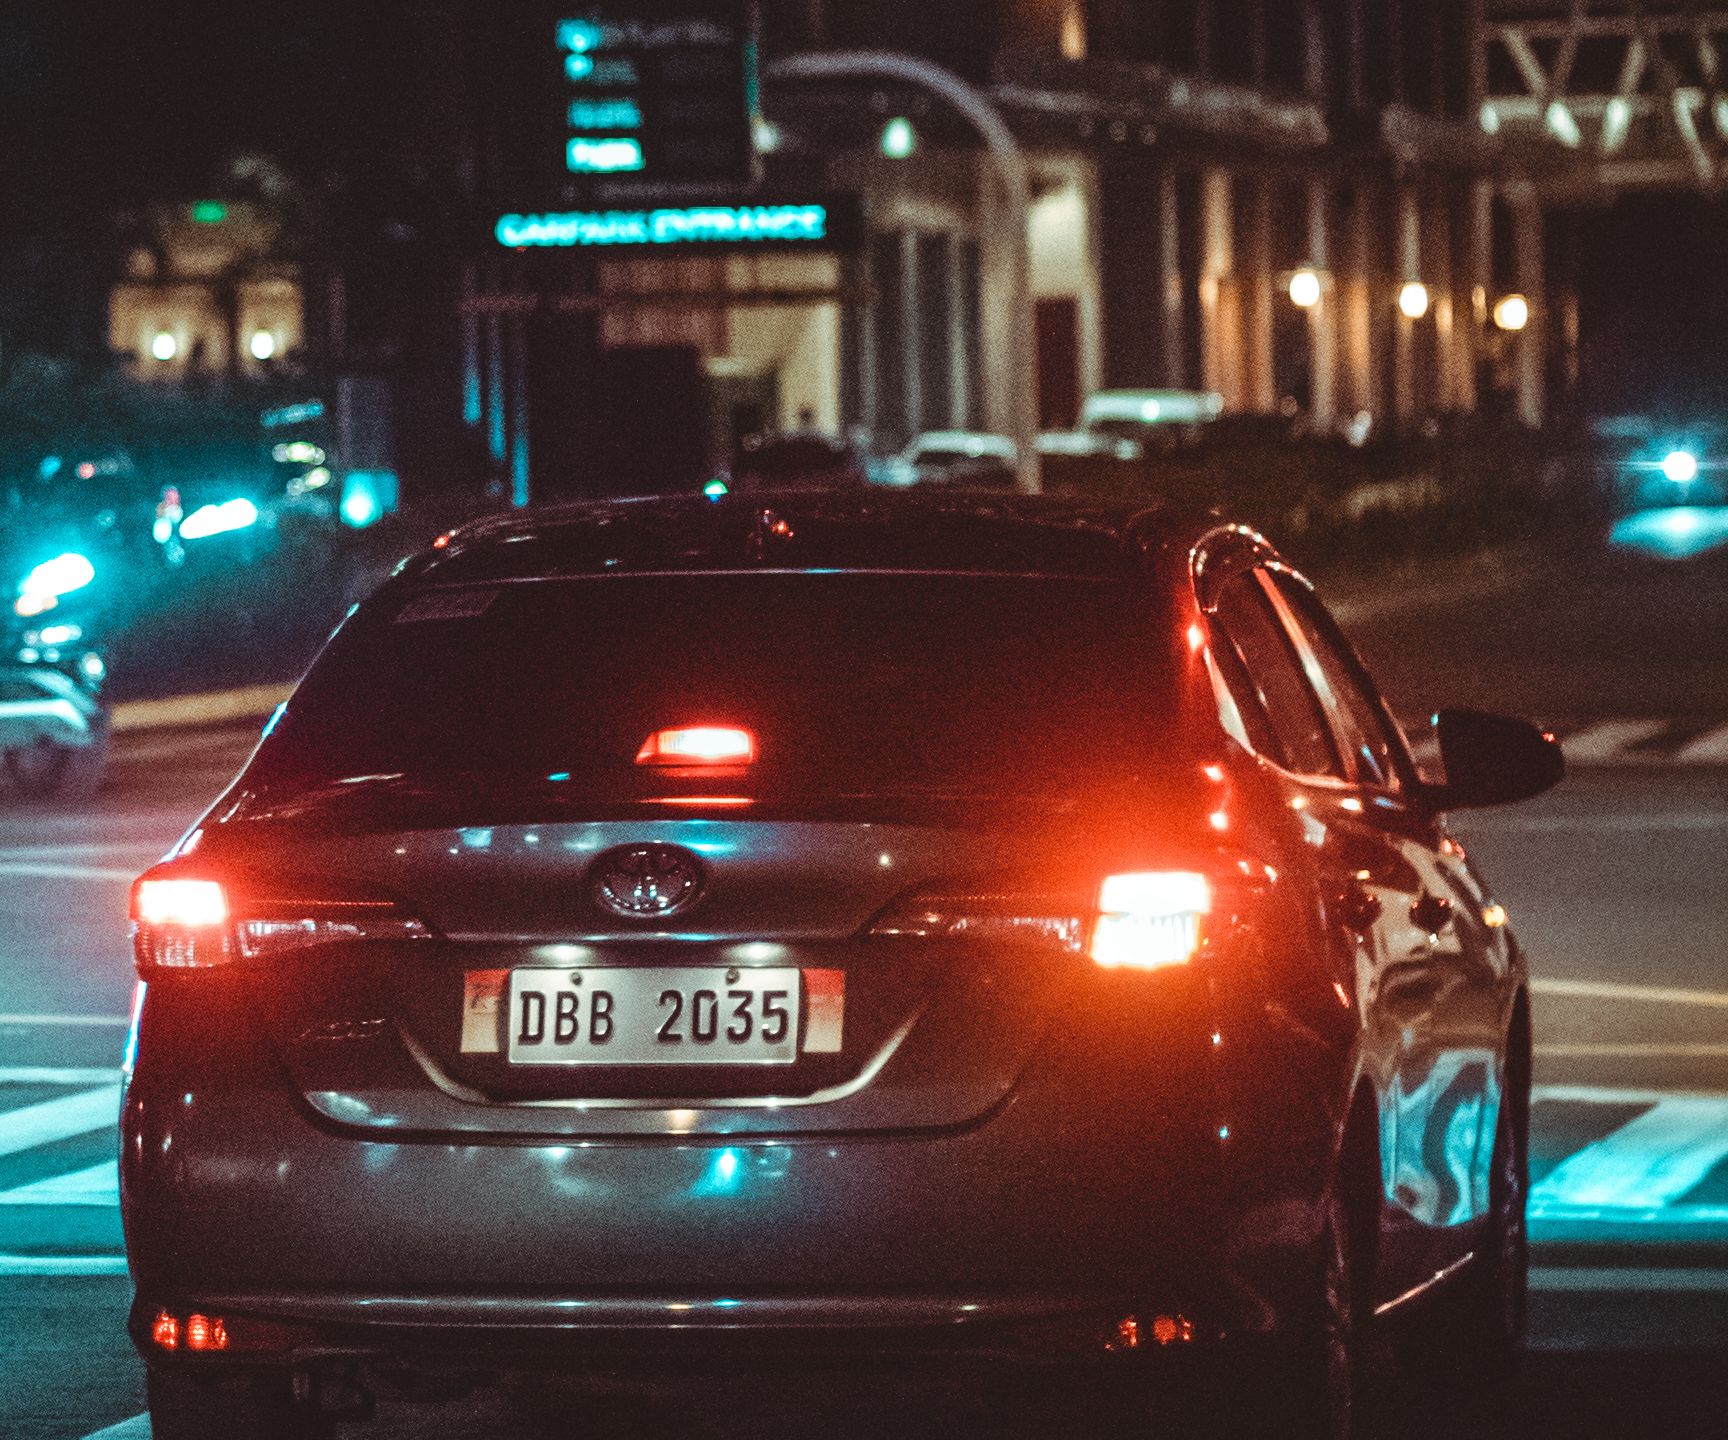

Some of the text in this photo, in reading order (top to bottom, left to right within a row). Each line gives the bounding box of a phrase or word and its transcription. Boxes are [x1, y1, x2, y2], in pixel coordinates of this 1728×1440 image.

[651, 206, 826, 243] ENTRANCE
[518, 989, 790, 1046] DBB 2035
